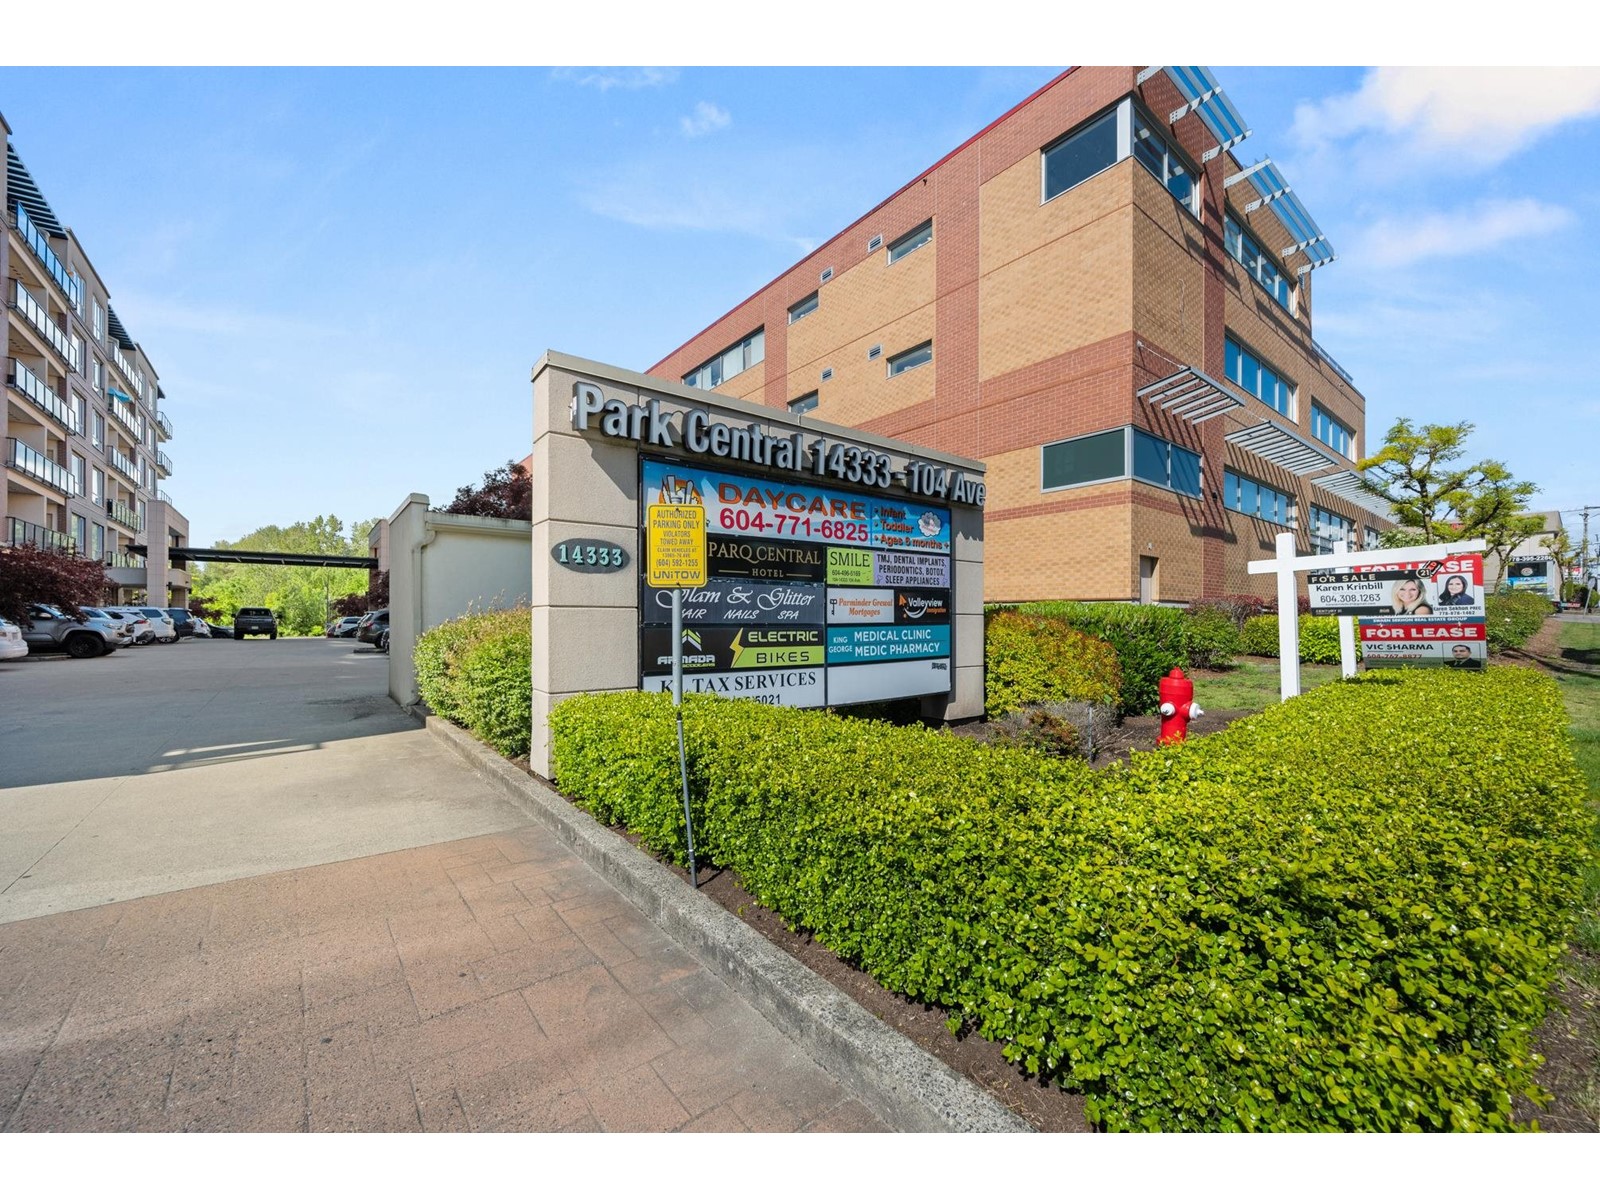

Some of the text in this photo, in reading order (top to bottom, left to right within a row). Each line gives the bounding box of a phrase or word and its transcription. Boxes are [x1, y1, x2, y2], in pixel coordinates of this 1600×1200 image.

[573, 381, 674, 447] Park
[682, 408, 803, 471] Central
[808, 439, 891, 489] 14333
[904, 460, 948, 498] 104
[949, 471, 986, 506] Ave
[718, 482, 867, 520] DAYCARE
[656, 510, 697, 519] AUTHORIZED
[880, 506, 906, 519] Infant
[653, 520, 700, 529] PARKING ONLY
[719, 507, 868, 542] 604-771-6825
[880, 520, 914, 533] Toddler
[880, 534, 903, 547] Ages
[912, 538, 943, 550] months
[559, 544, 623, 566] 14333
[708, 542, 821, 565] PARQ CENTRAL
[830, 551, 870, 568] SMILE
[877, 553, 893, 564] TMJ,
[894, 555, 916, 565] DENTAL
[656, 559, 671, 568] (604)
[752, 568, 784, 577] HOTEL
[1342, 573, 1376, 582] SALE
[1420, 569, 1430, 577] 21
[885, 576, 940, 586] SLEEP APPLIANCES
[1316, 582, 1383, 592] Karen Krinbill
[727, 586, 754, 604] &
[757, 587, 816, 611] Glitter
[838, 598, 872, 607] Parminder
[908, 597, 943, 609] Valleyview
[1320, 593, 1381, 603] 604.308.1263
[681, 608, 799, 620] AIR NAILS SPA
[848, 608, 880, 617] Mortgages
[748, 631, 818, 642] ELECTRIC
[854, 629, 932, 642] MEDICAL CLINIC
[1366, 627, 1478, 638] FOR LEASE
[855, 643, 940, 657] MEDIC PHARMACY
[757, 651, 810, 664] BIKES
[692, 677, 730, 693] TAX
[734, 671, 816, 691] SERVICES
